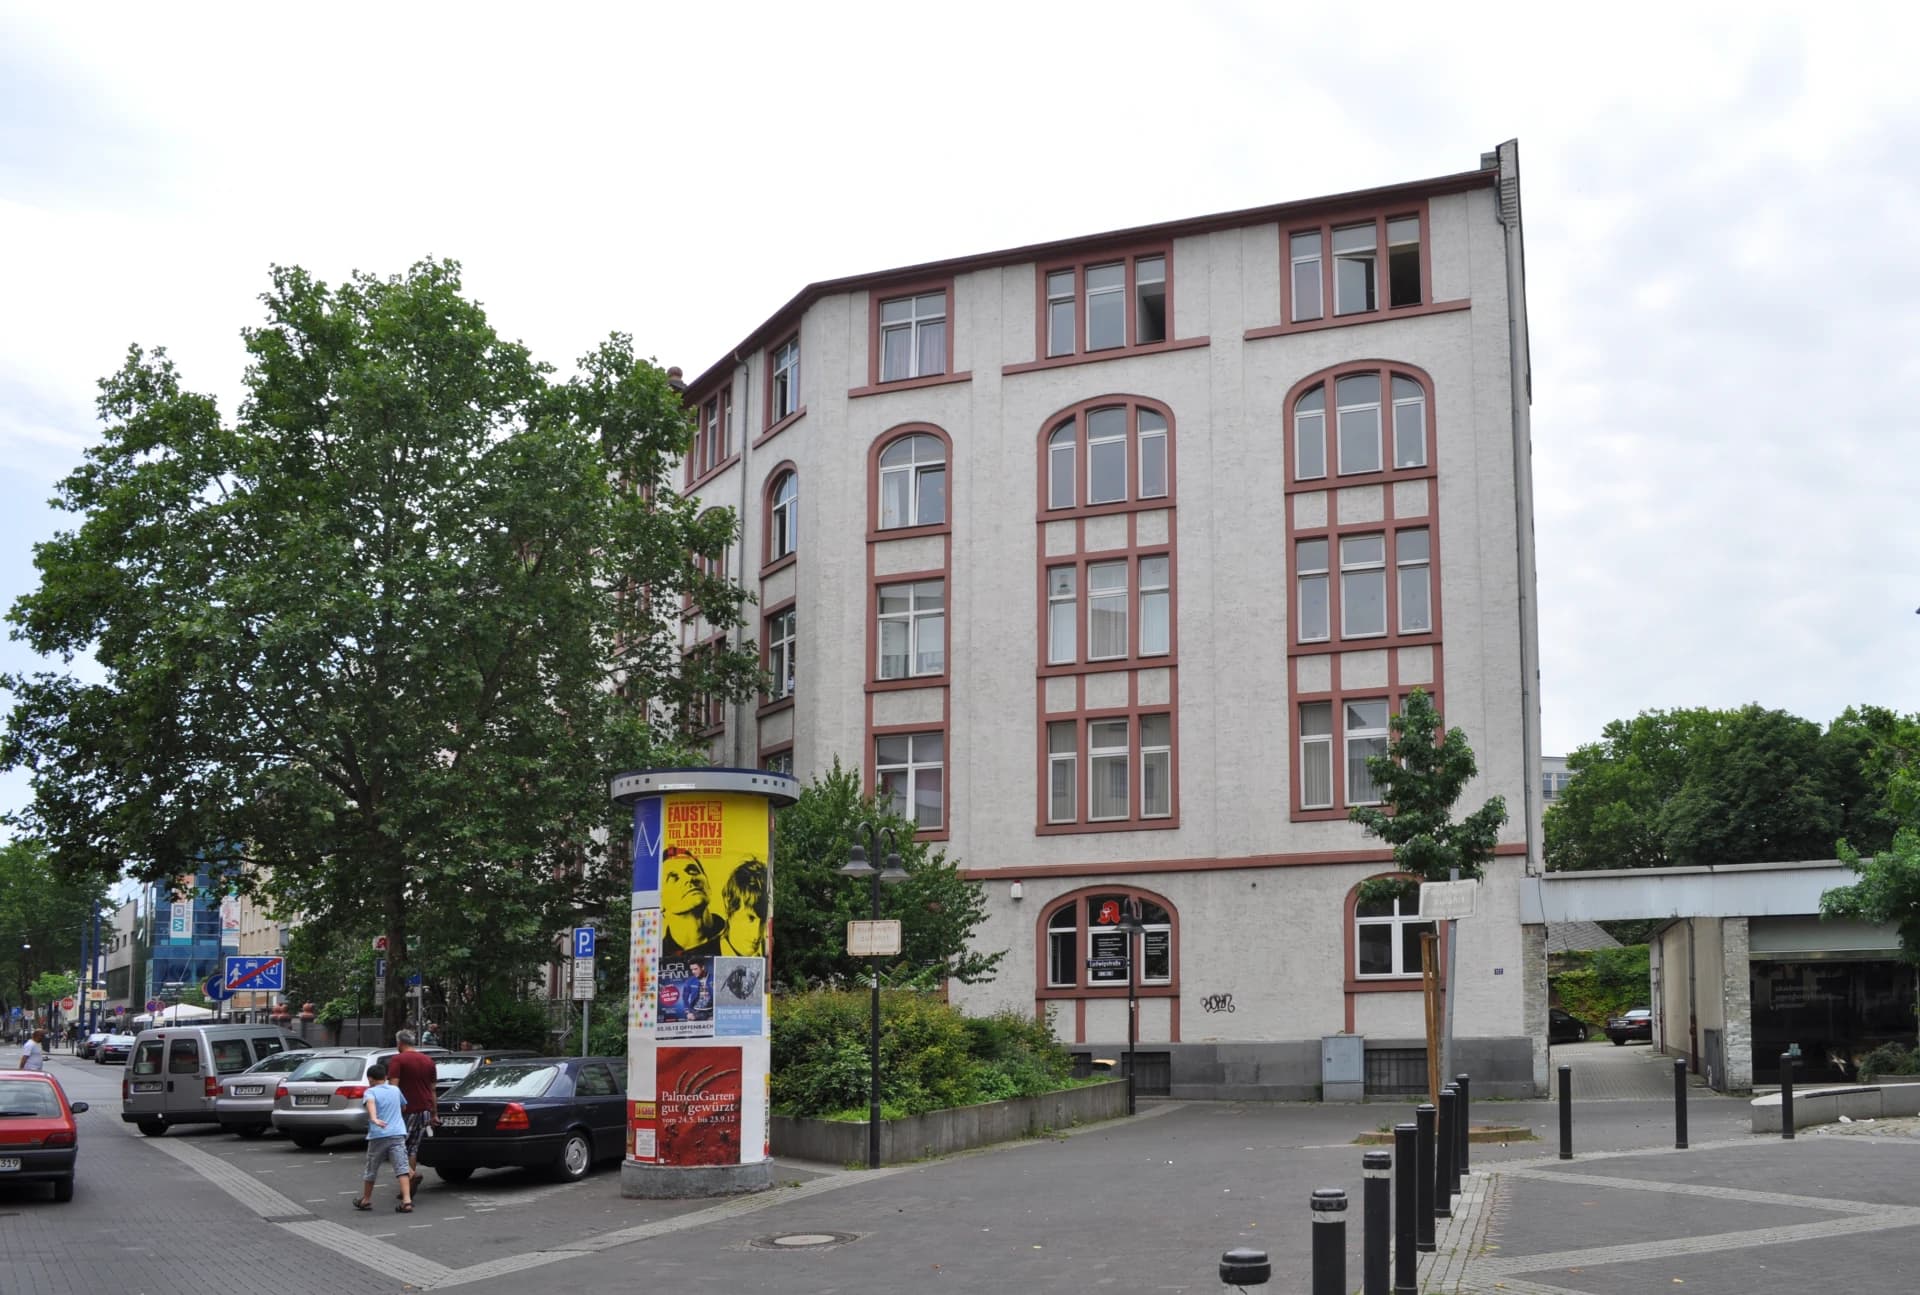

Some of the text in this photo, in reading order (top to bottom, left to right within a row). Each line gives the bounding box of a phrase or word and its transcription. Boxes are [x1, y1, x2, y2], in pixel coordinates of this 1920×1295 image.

[668, 805, 705, 822] FAUST
[679, 1023, 714, 1031] OFFENBACH
[662, 1090, 735, 1101] PalmenGarten
[661, 1103, 680, 1116] gut
[687, 1101, 735, 1116] gewürzt
[697, 1115, 708, 1123] bis
